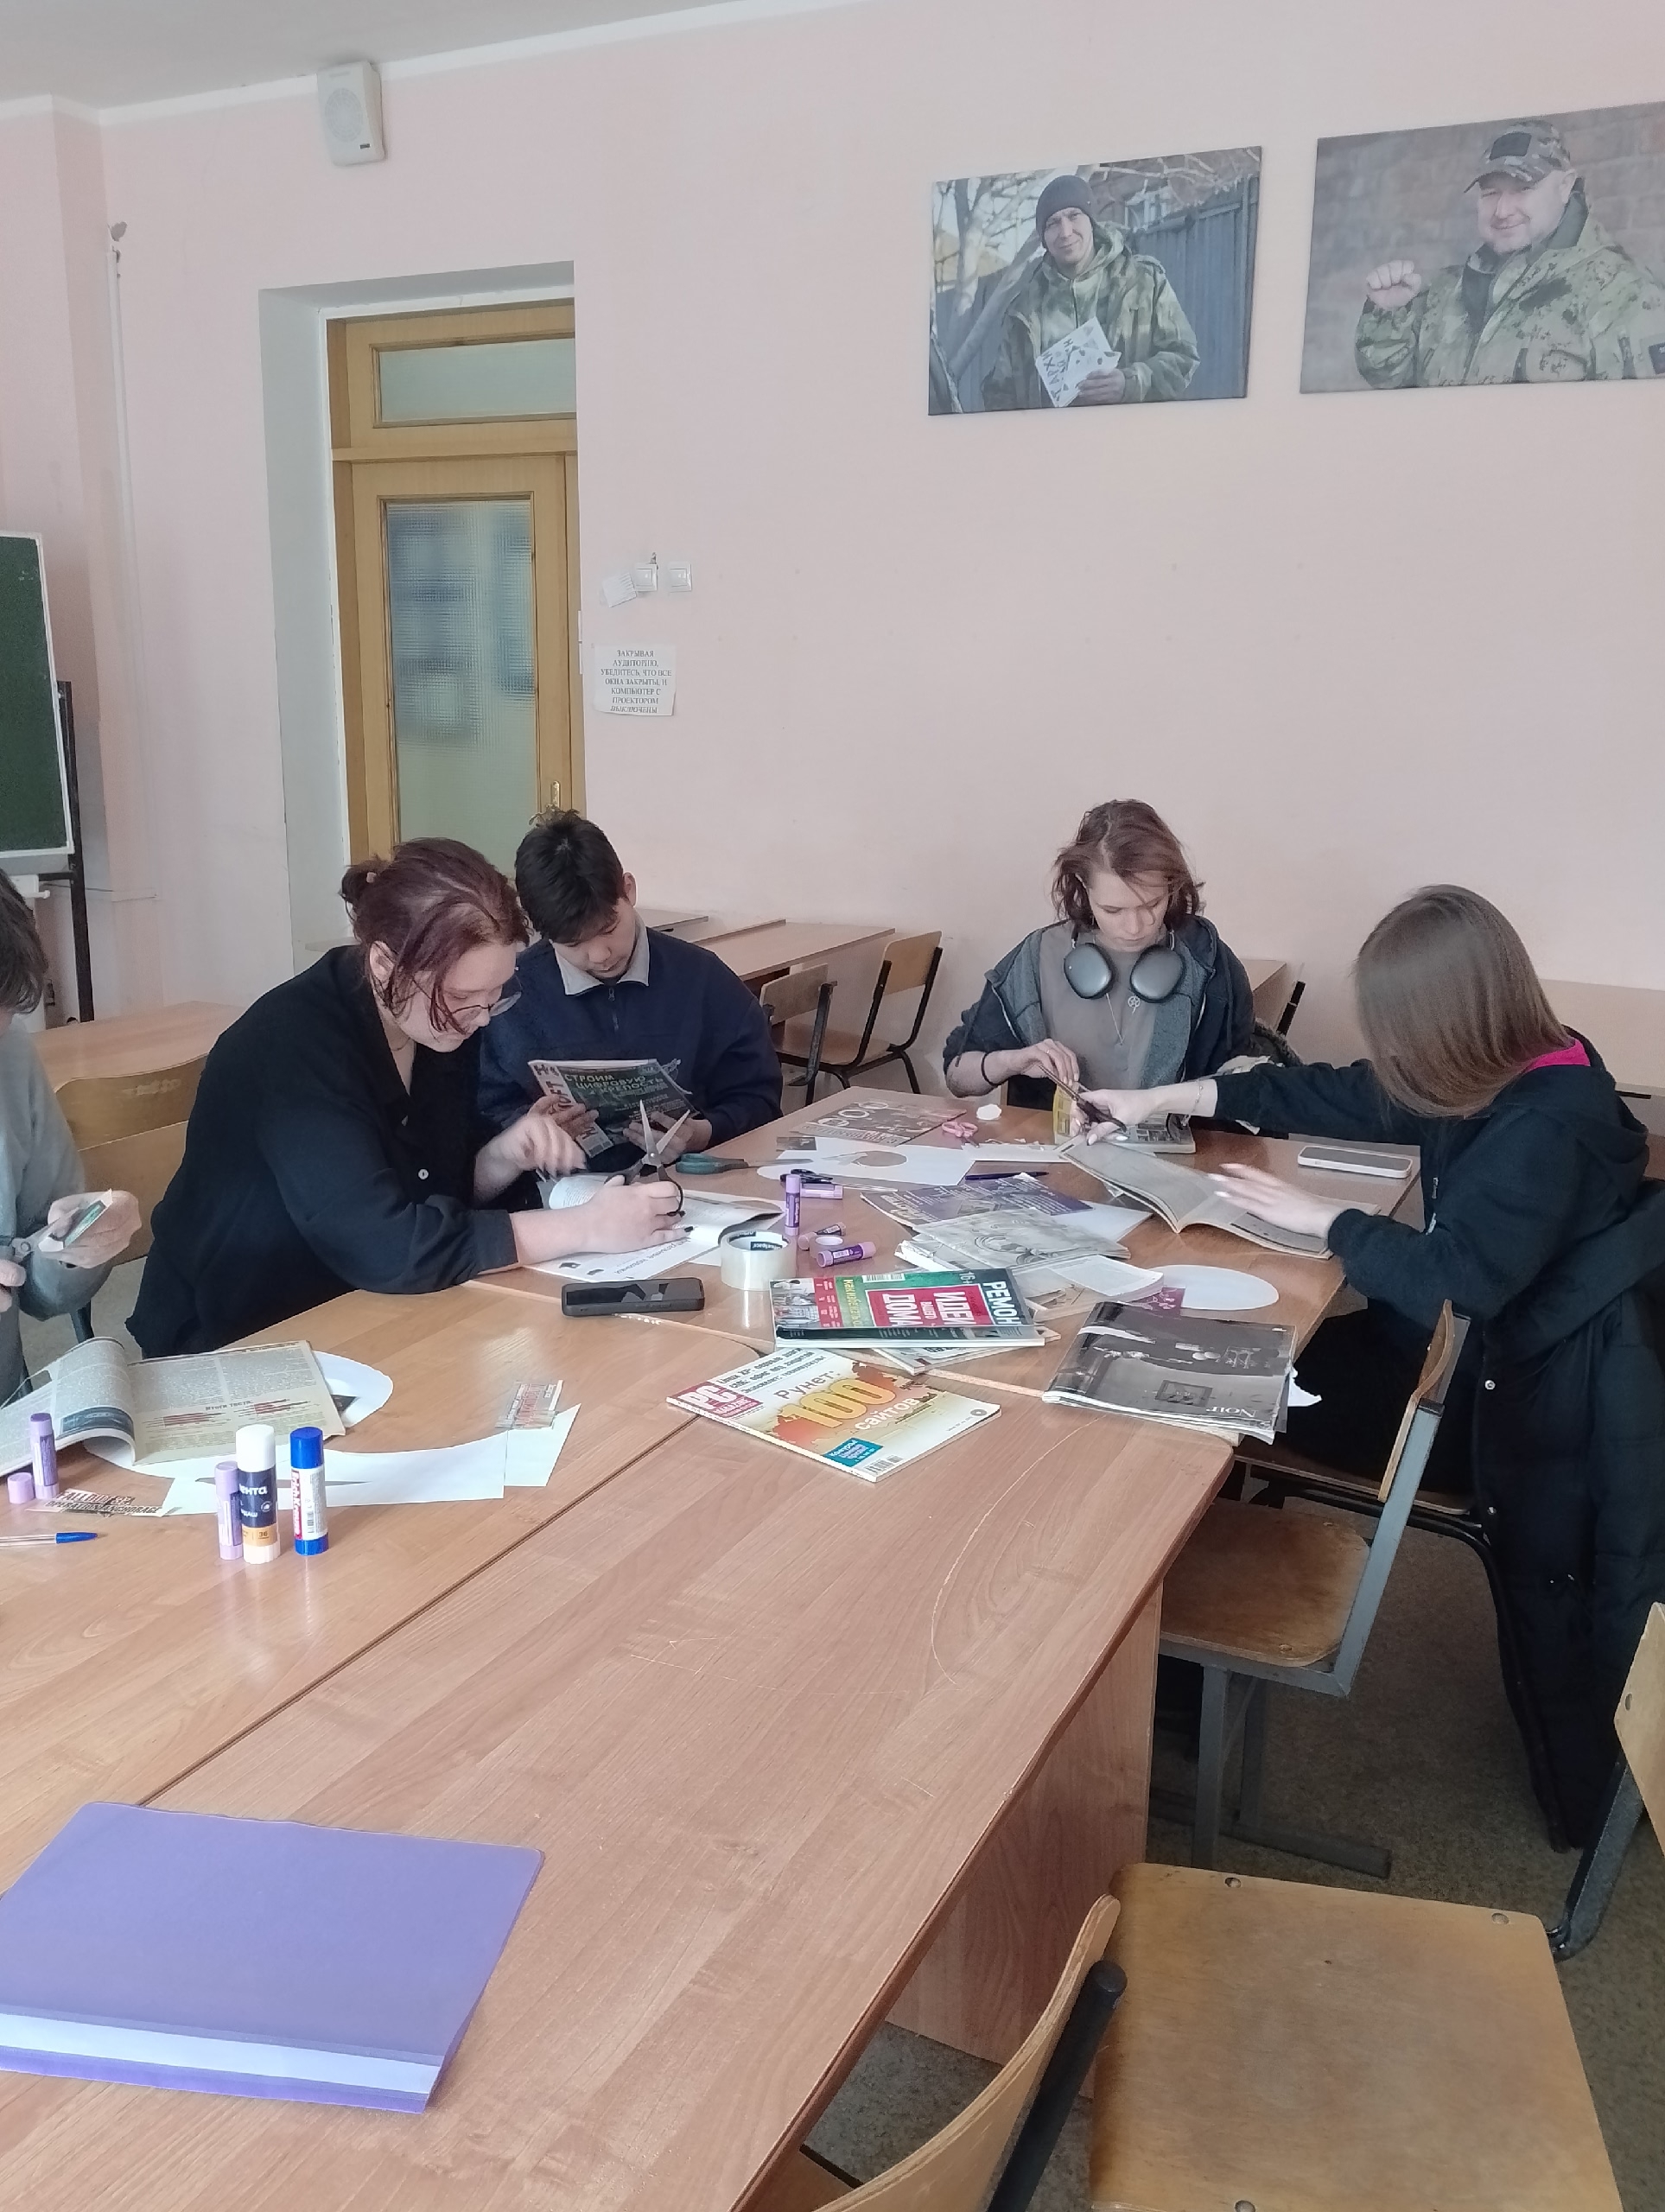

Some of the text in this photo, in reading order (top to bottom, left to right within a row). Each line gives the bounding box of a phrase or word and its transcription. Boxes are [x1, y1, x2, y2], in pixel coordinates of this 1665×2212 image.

[563, 1073, 615, 1083] СТРОИМ
[575, 1075, 646, 1090] ЦИФРОВУЮ
[599, 1077, 664, 1092] КРЕПОСТЬ
[958, 1271, 976, 1284] 16+
[881, 1294, 924, 1326] ДОМА
[933, 1291, 977, 1325] ИДЕИ
[982, 1281, 1023, 1325] РЕМОН
[677, 1385, 738, 1410] PC
[774, 1370, 842, 1401] Рунет:
[778, 1378, 897, 1429] 100
[854, 1396, 920, 1431] сайтов
[239, 1484, 268, 1496] ента
